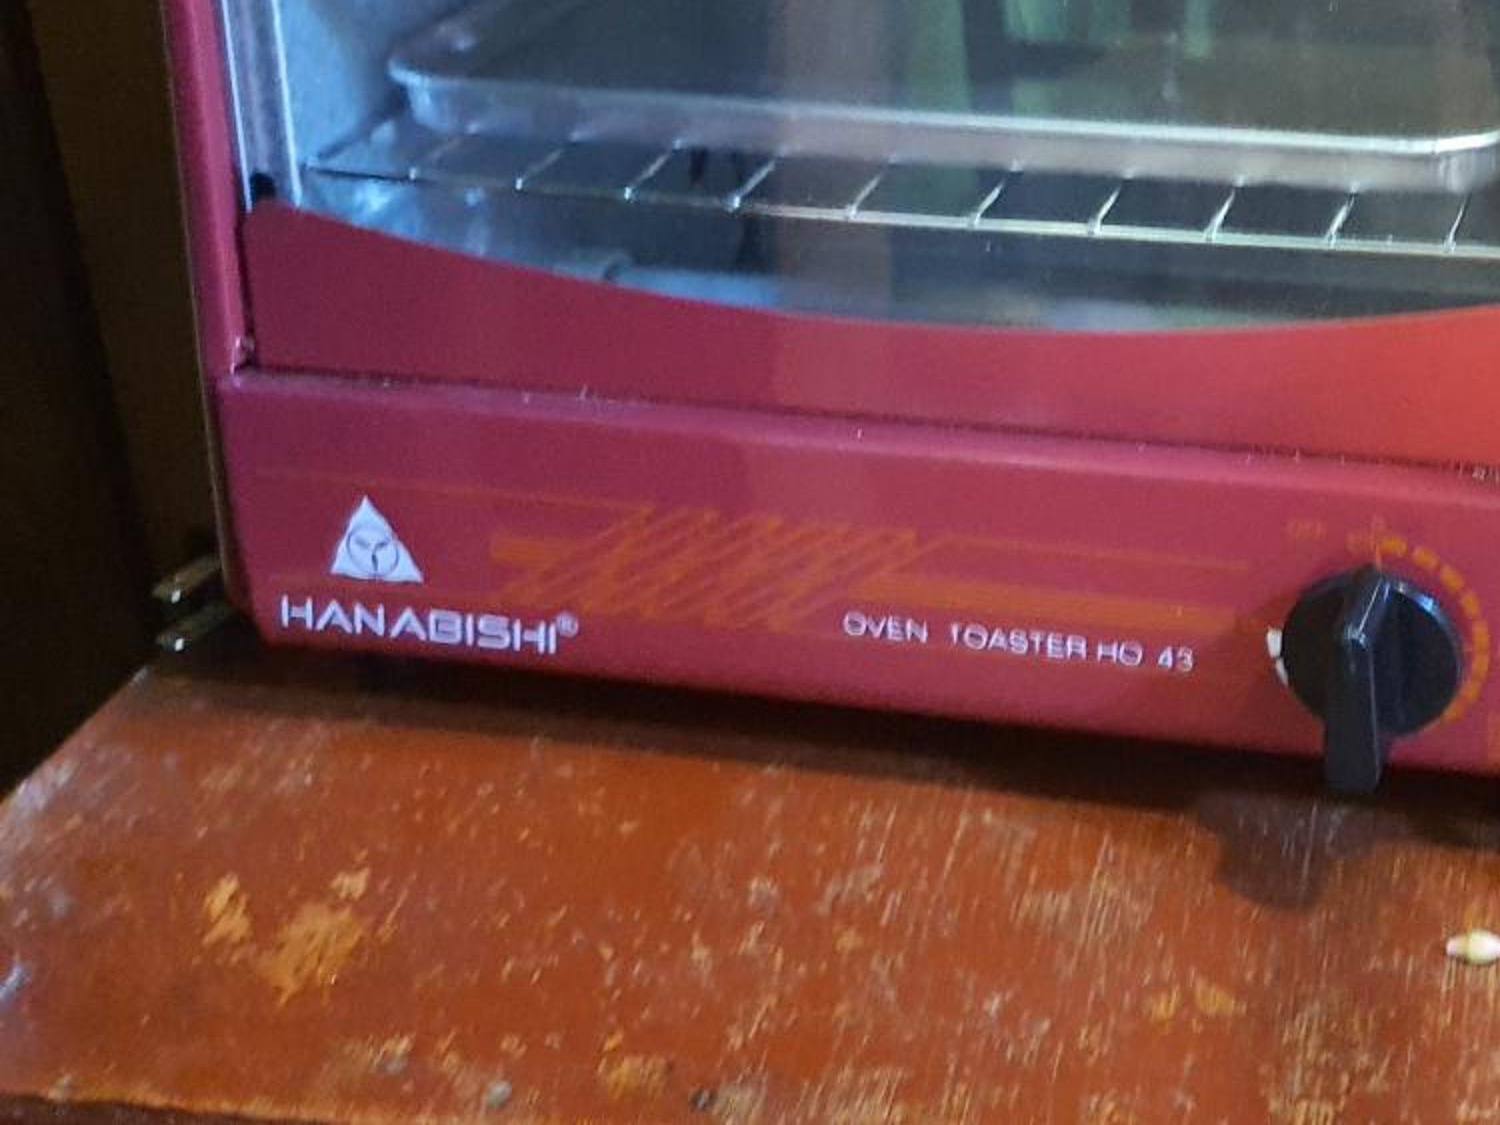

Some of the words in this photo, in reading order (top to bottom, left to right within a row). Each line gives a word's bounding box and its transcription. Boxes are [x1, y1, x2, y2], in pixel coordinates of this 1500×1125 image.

[842, 610, 928, 643] OVEN
[950, 622, 1087, 661] TOASTER
[1157, 645, 1194, 673] 43
